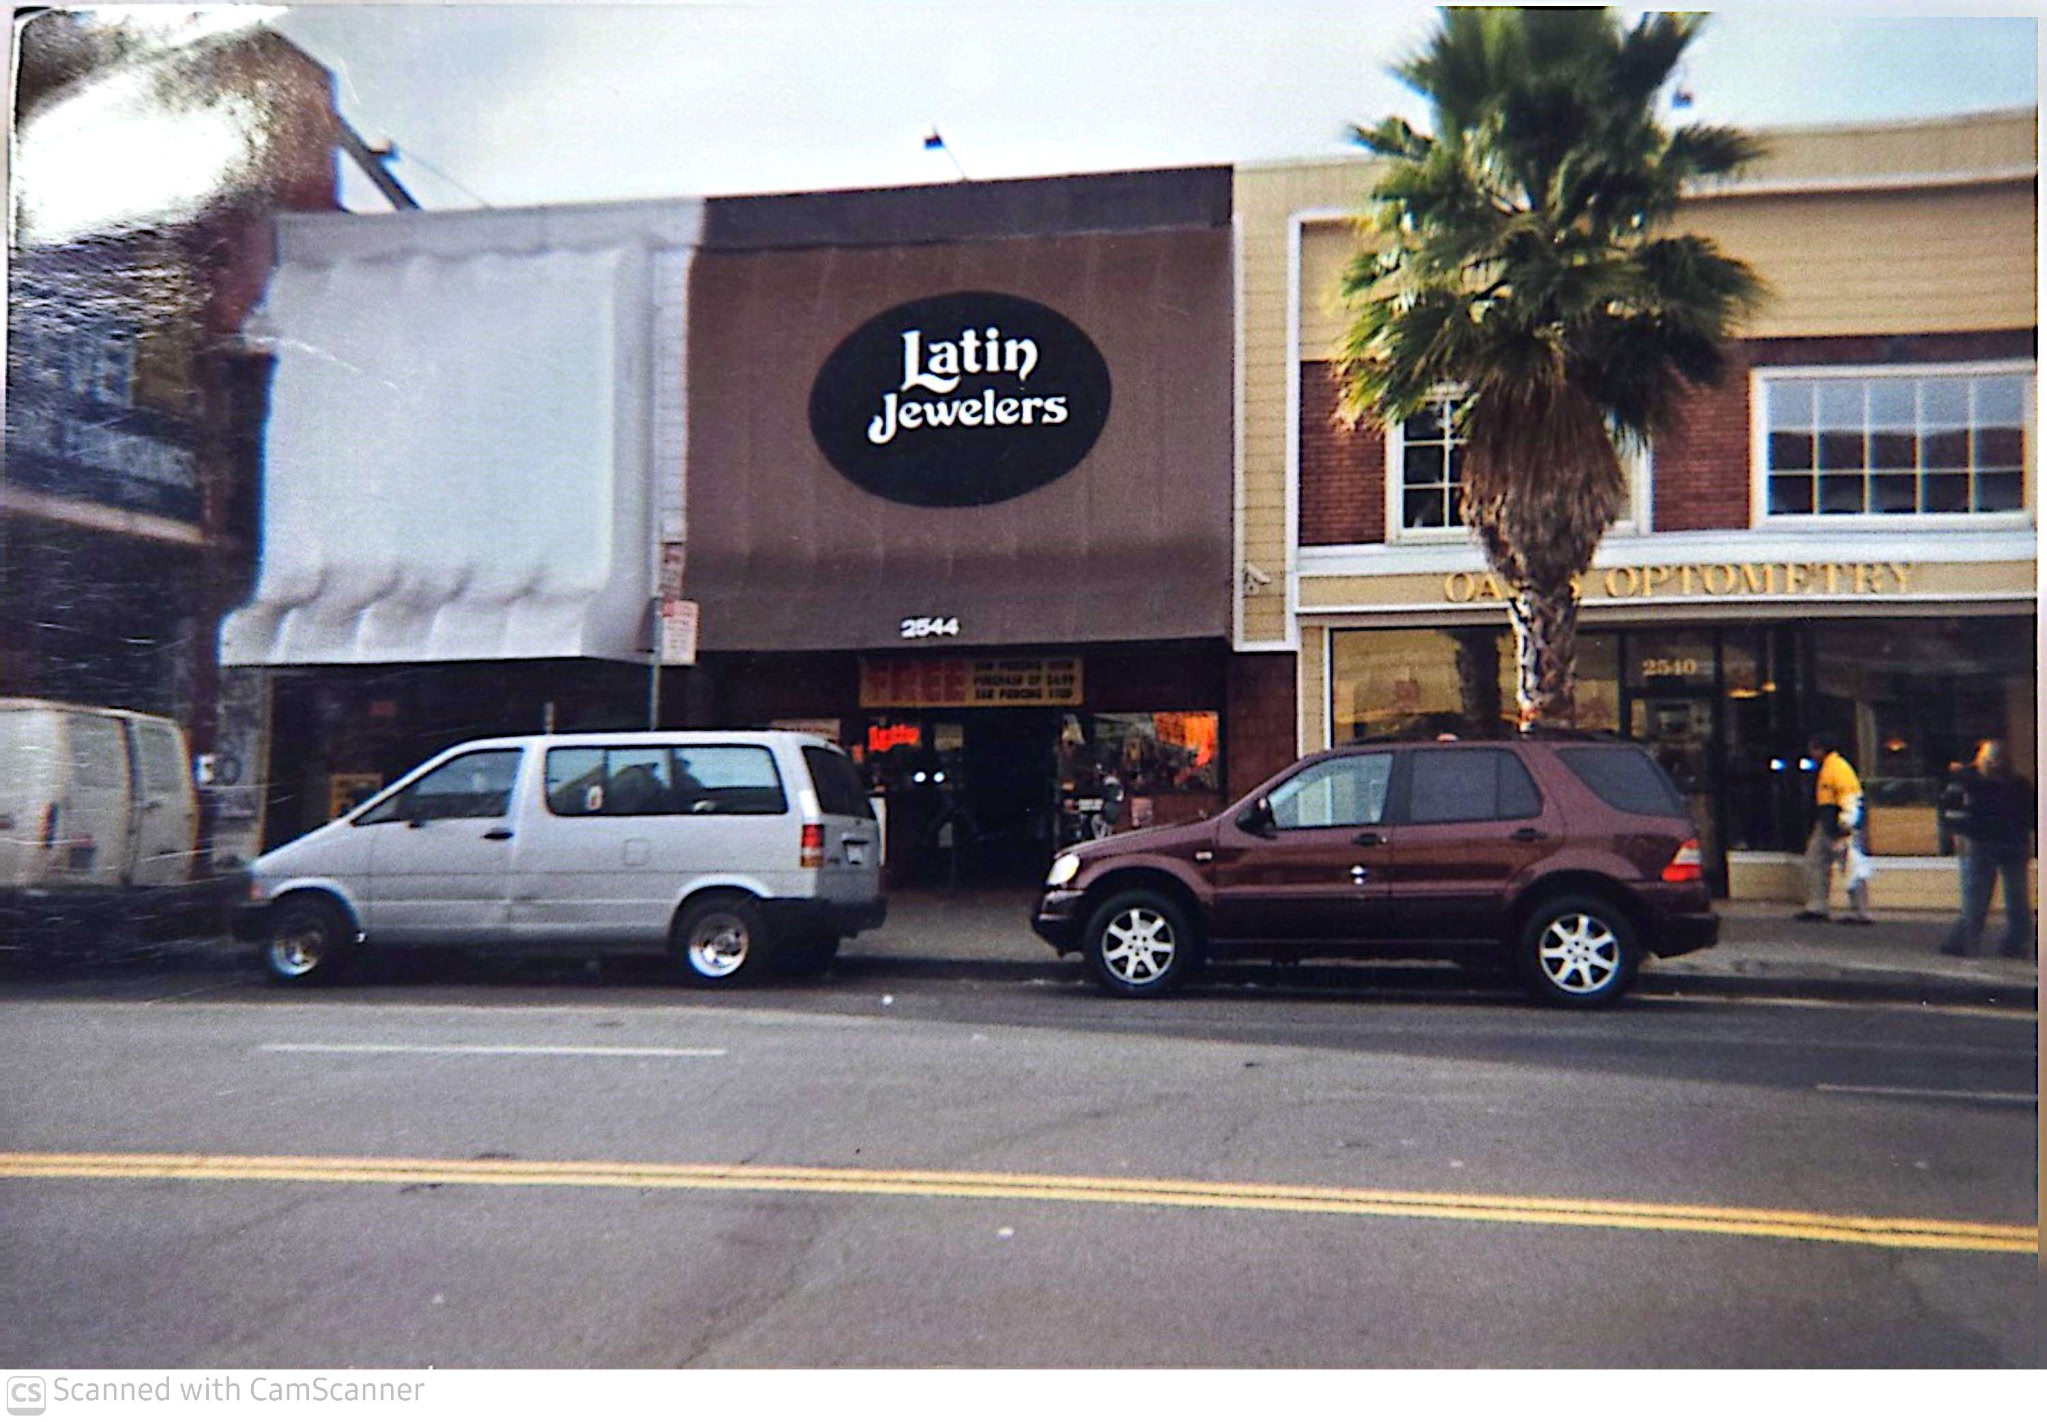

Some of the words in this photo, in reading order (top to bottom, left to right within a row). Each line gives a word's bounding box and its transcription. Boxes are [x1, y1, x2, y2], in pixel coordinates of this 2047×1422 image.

[901, 326, 1039, 394] Latin
[867, 388, 1069, 445] Jewelers
[1604, 562, 1912, 599] OPTOMETRY
[900, 616, 960, 639] 2544
[1641, 658, 1697, 677] 2540
